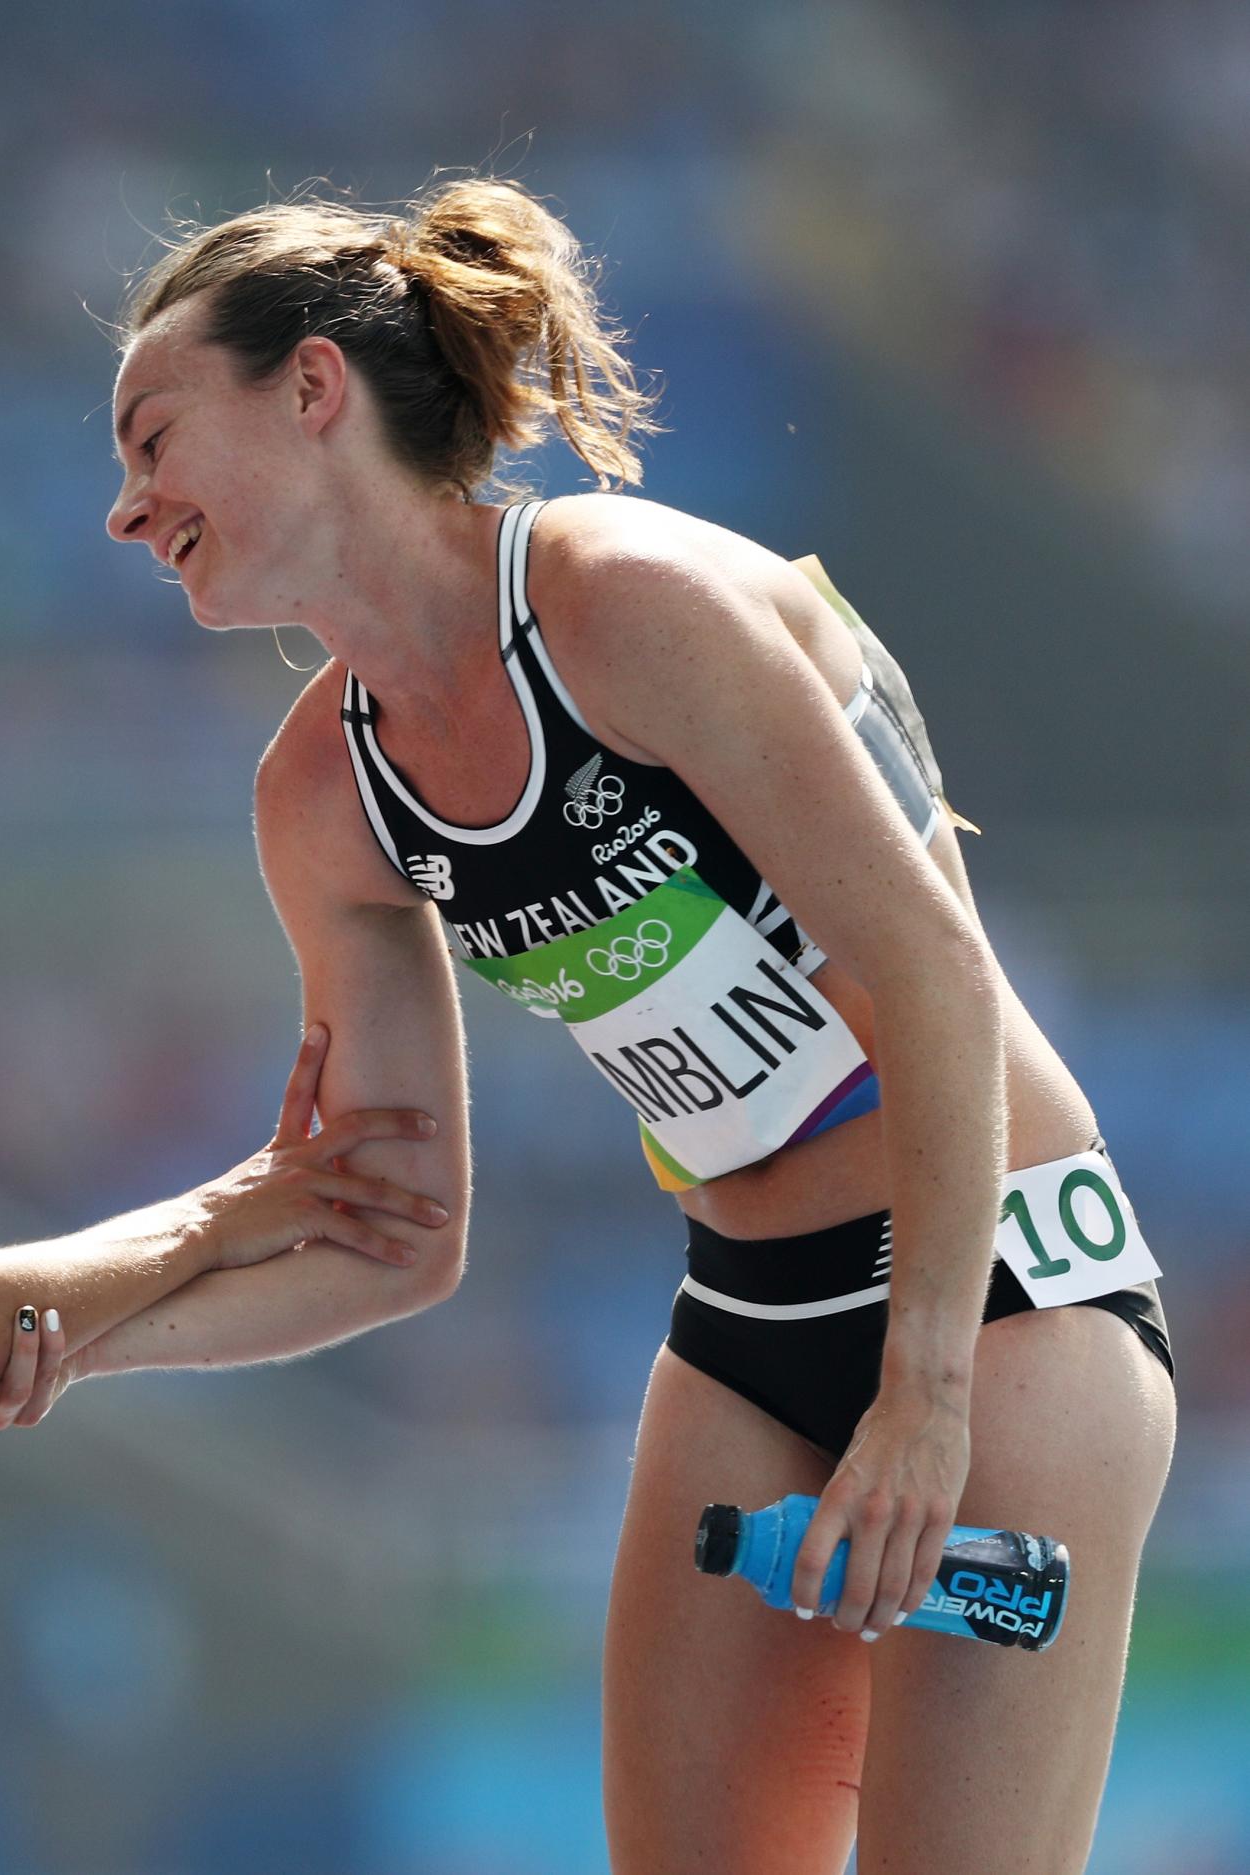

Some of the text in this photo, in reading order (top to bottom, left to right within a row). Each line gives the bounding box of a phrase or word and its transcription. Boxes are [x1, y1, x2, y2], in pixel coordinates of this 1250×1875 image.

[505, 829, 698, 950] ZEALAND
[591, 958, 827, 1124] MBLIN
[999, 1168, 1126, 1279] 10
[949, 1570, 1053, 1619] PRO
